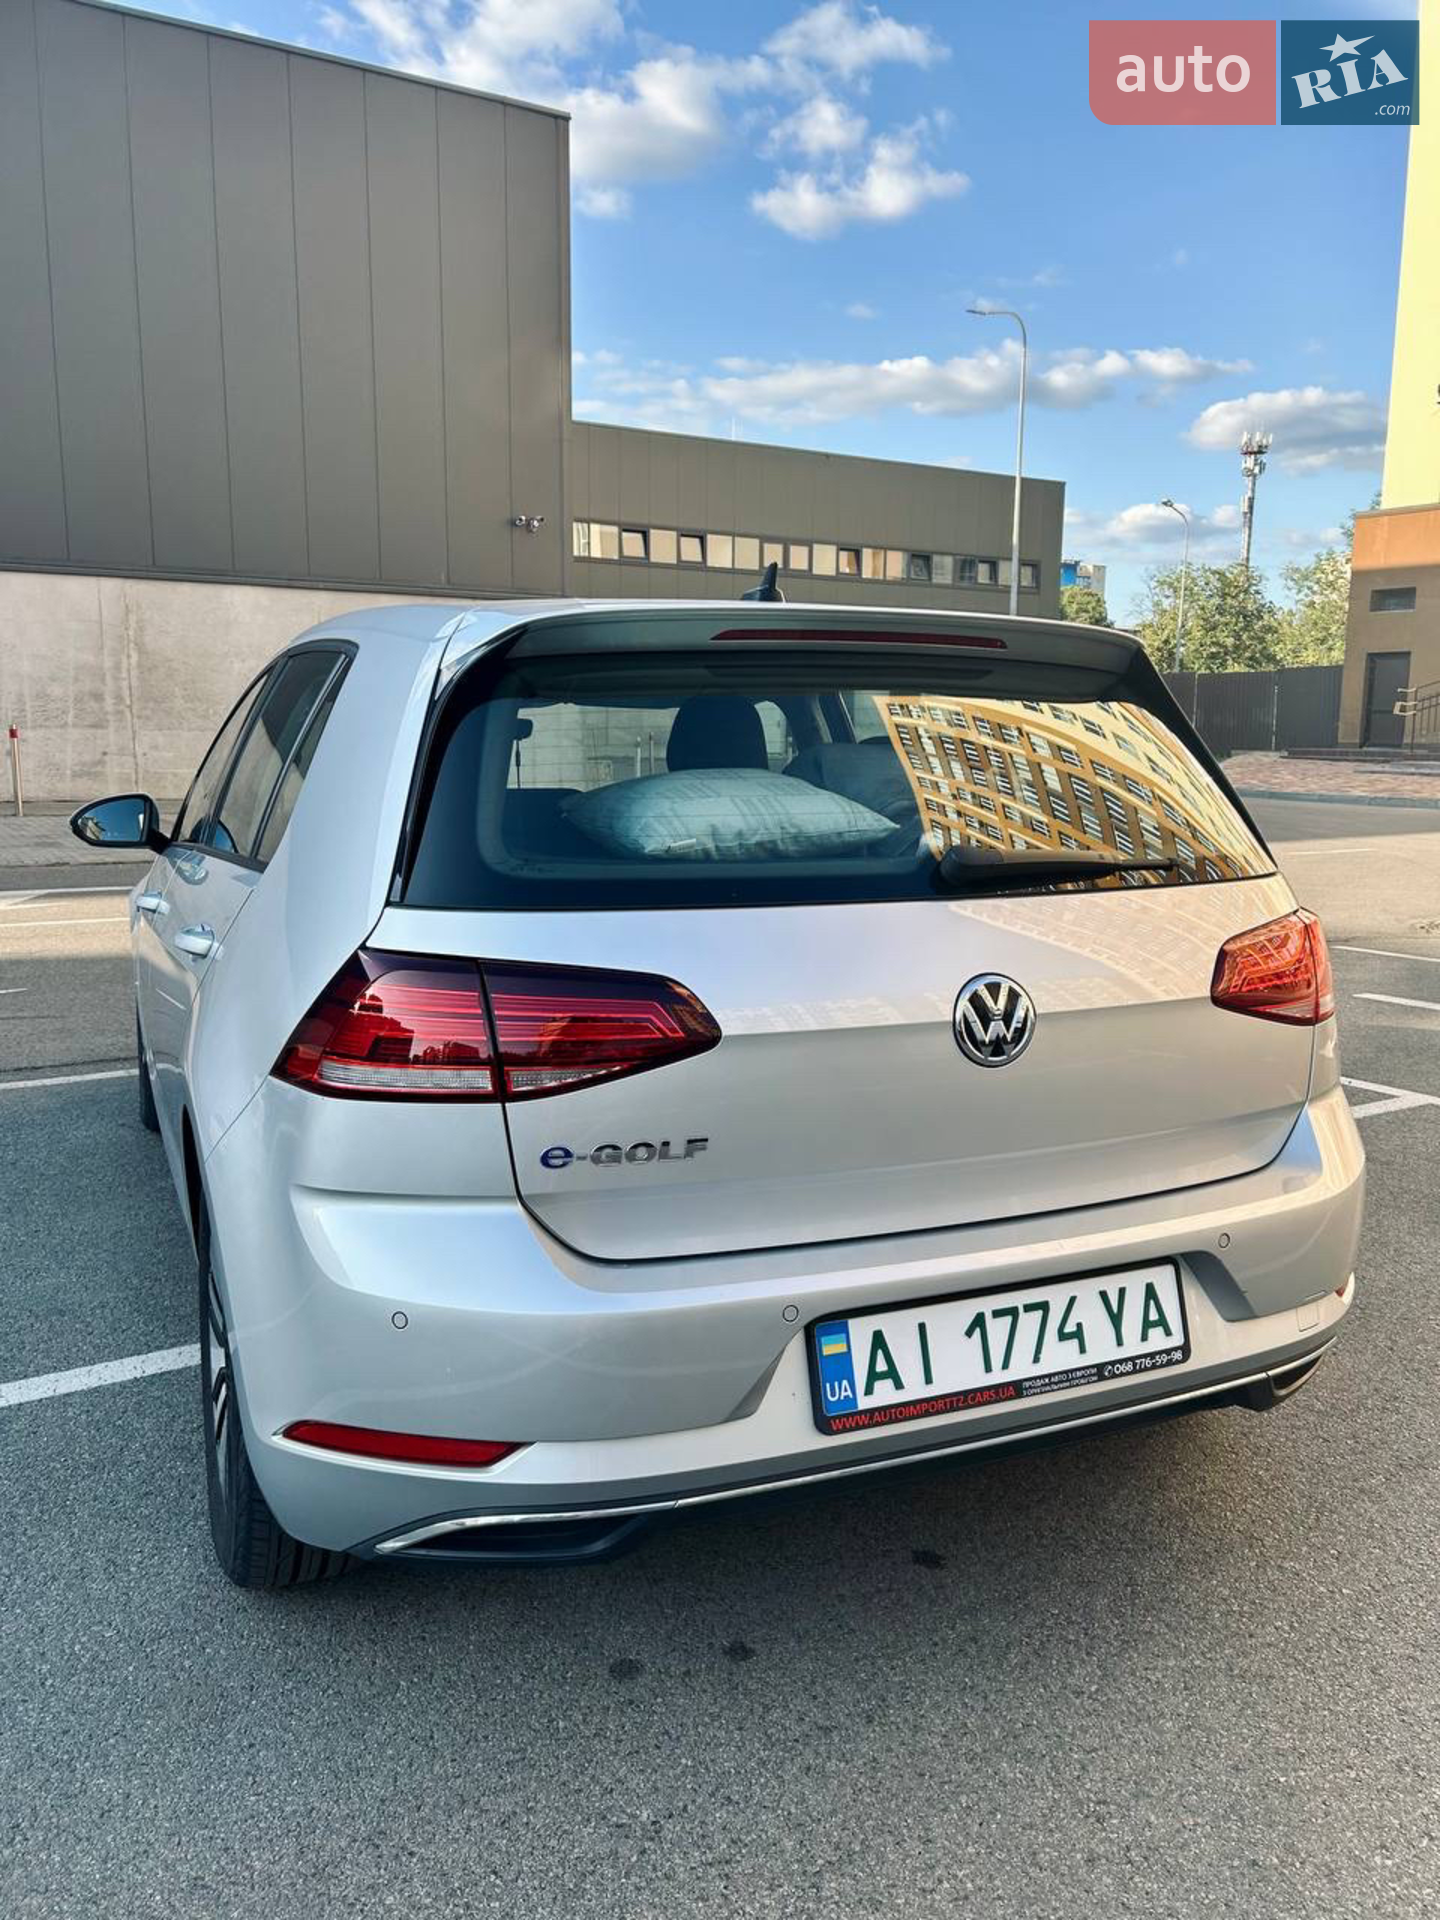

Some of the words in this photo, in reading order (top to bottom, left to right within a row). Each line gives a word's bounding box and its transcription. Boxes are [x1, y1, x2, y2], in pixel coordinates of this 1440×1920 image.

[539, 1137, 709, 1170] e-GOLF
[964, 1295, 1087, 1375] 1774
[1098, 1281, 1174, 1348] YA
[1113, 1361, 1133, 1375] 068
[1135, 1349, 1183, 1370] 776-59-98
[825, 1379, 853, 1402] UA
